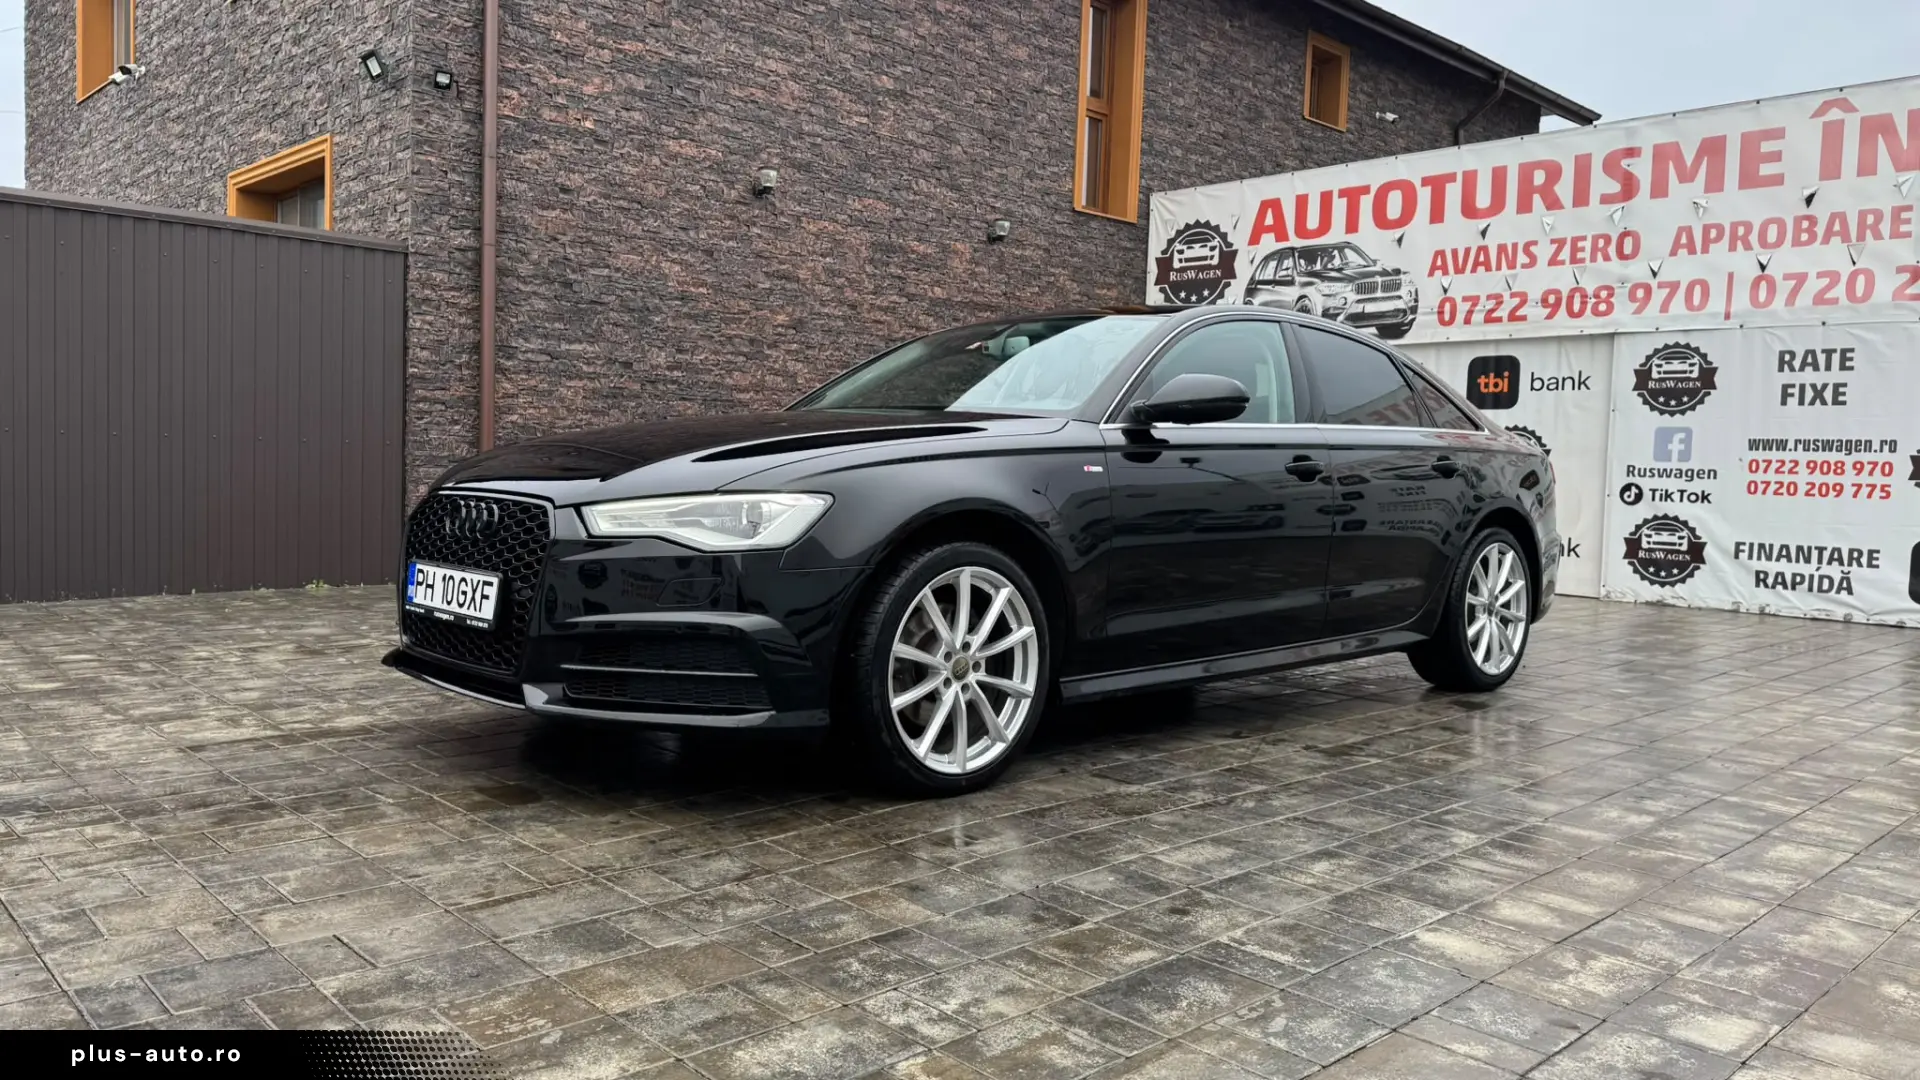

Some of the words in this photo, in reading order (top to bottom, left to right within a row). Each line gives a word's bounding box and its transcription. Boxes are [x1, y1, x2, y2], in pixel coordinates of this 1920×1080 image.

[1247, 126, 1786, 247] AUTOTURISME
[1809, 97, 1920, 182] ÎN
[1427, 239, 1539, 278] AVANS
[1547, 229, 1642, 267] ZERO
[1668, 204, 1914, 257] APROBARE
[1437, 290, 1528, 327] 0722
[1540, 284, 1615, 321] 908
[1628, 278, 1710, 315] 970
[1749, 268, 1876, 310] 0720
[1777, 347, 1856, 373] RATE
[1477, 371, 1510, 394] tbi
[1529, 370, 1592, 392] bank
[1780, 382, 1848, 407] FIXE
[1748, 438, 1898, 456] www.ruswagen.ro
[1626, 464, 1718, 482] Ruswagen
[1748, 458, 1800, 475] 0722
[1805, 460, 1846, 476] 908
[1852, 461, 1894, 477] 970
[1649, 488, 1712, 504] TikTok
[1746, 480, 1798, 496] 0720
[1804, 481, 1844, 498] 209
[1851, 483, 1892, 500] 775
[415, 568, 436, 602] PH
[1754, 569, 1854, 596] RAPIDĂ
